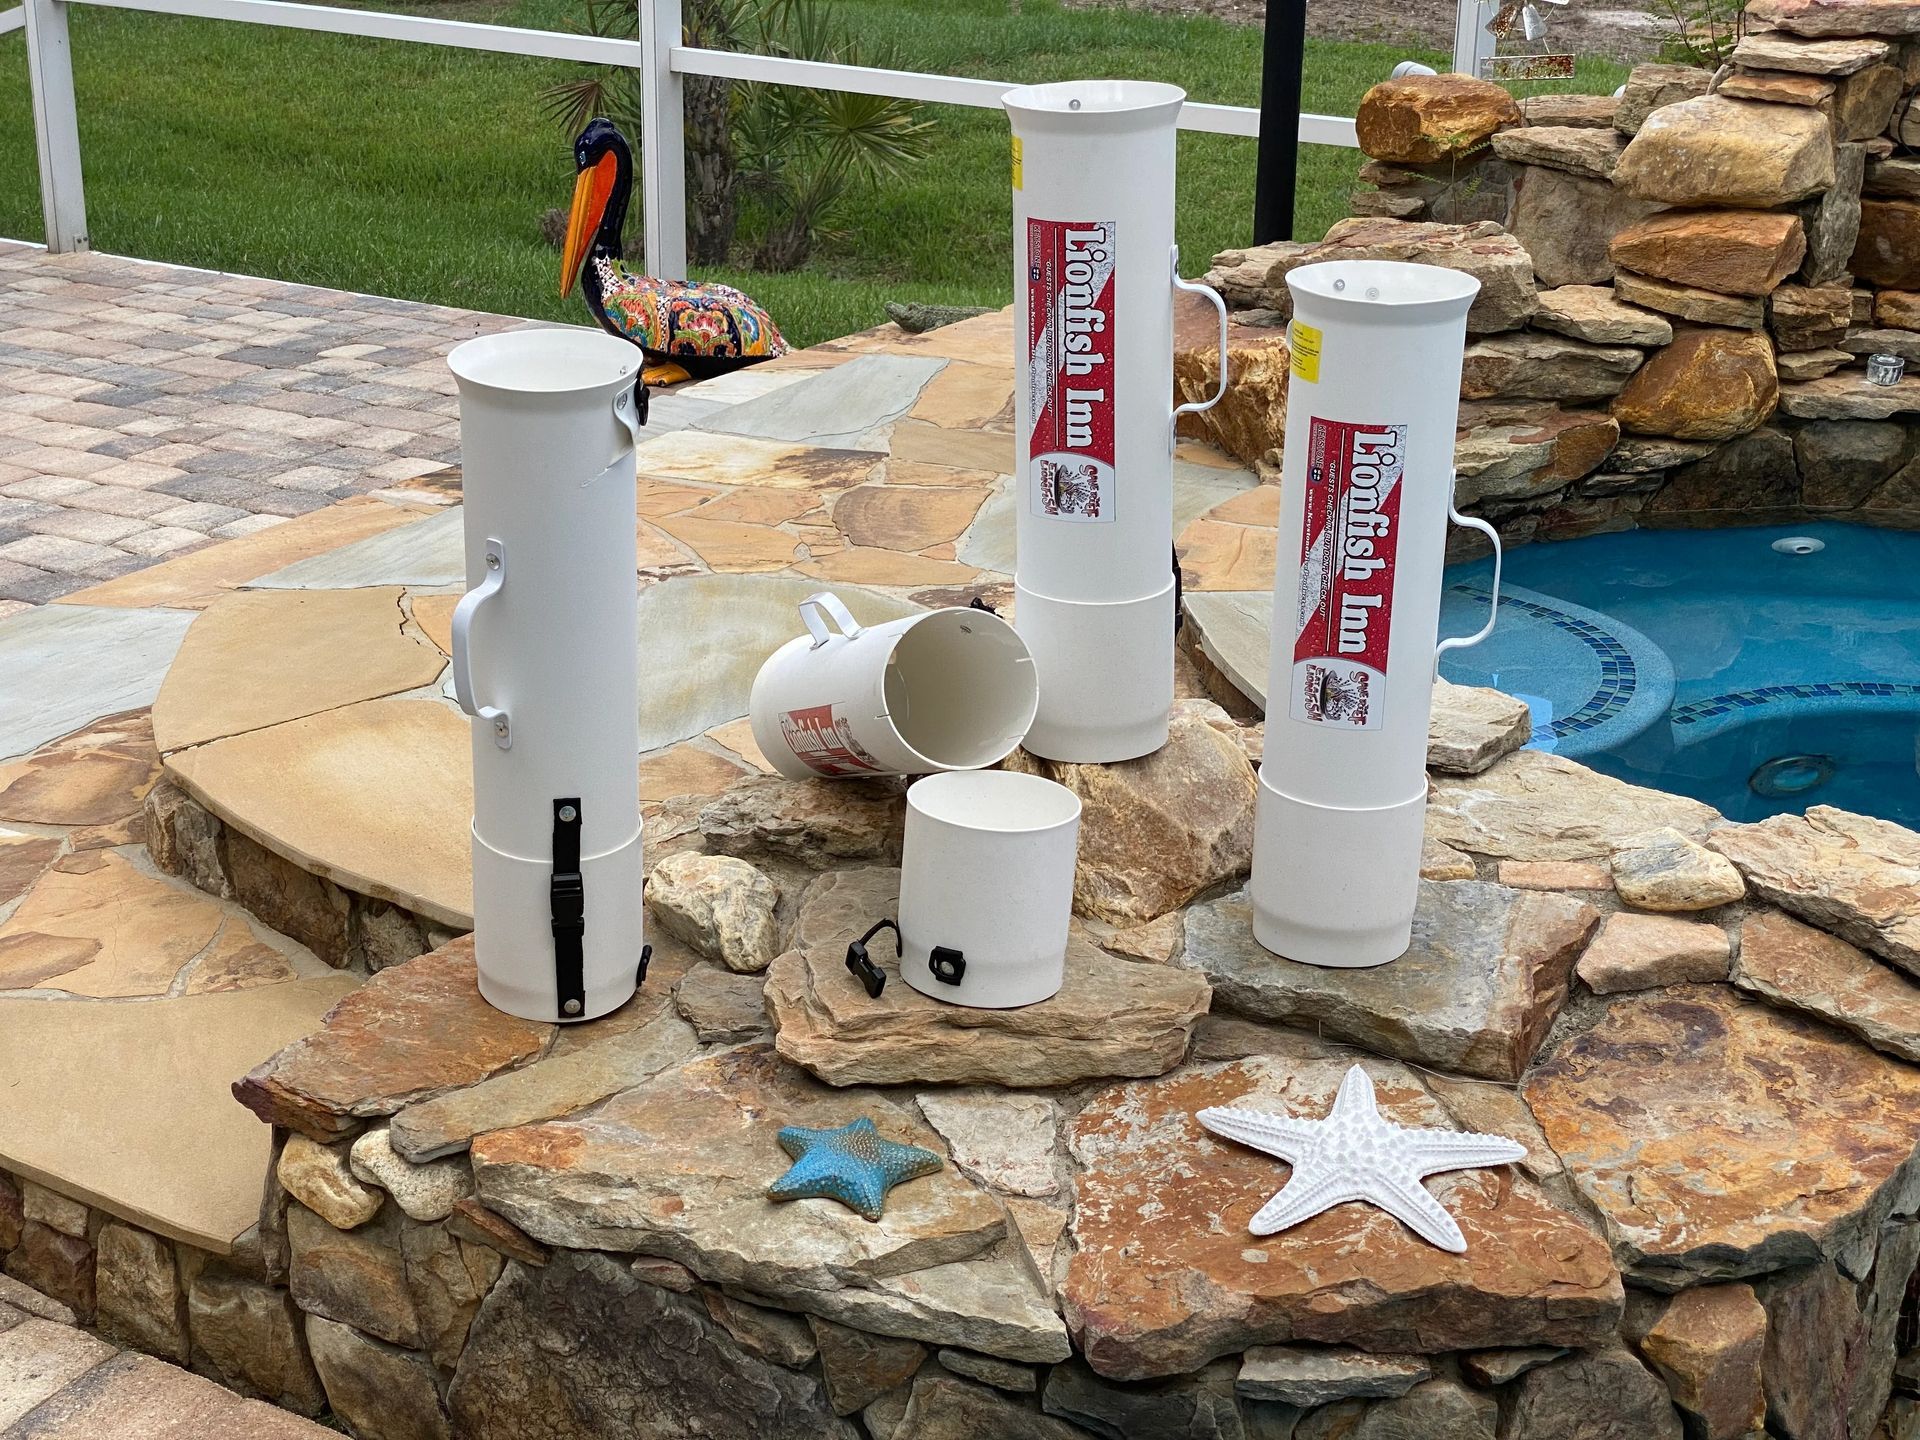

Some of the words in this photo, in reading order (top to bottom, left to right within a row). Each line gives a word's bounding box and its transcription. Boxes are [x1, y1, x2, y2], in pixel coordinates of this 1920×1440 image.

[1033, 224, 1041, 268] KEYSTONE
[1064, 227, 1106, 376] Lionfish
[1064, 387, 1105, 448] Inn
[1316, 424, 1326, 469] KEYSTONE
[1343, 430, 1397, 581] Lionfish
[1324, 532, 1332, 550] BUT
[1320, 573, 1329, 600] CHECK
[1337, 593, 1382, 654] Inn
[815, 716, 844, 750] Inn
